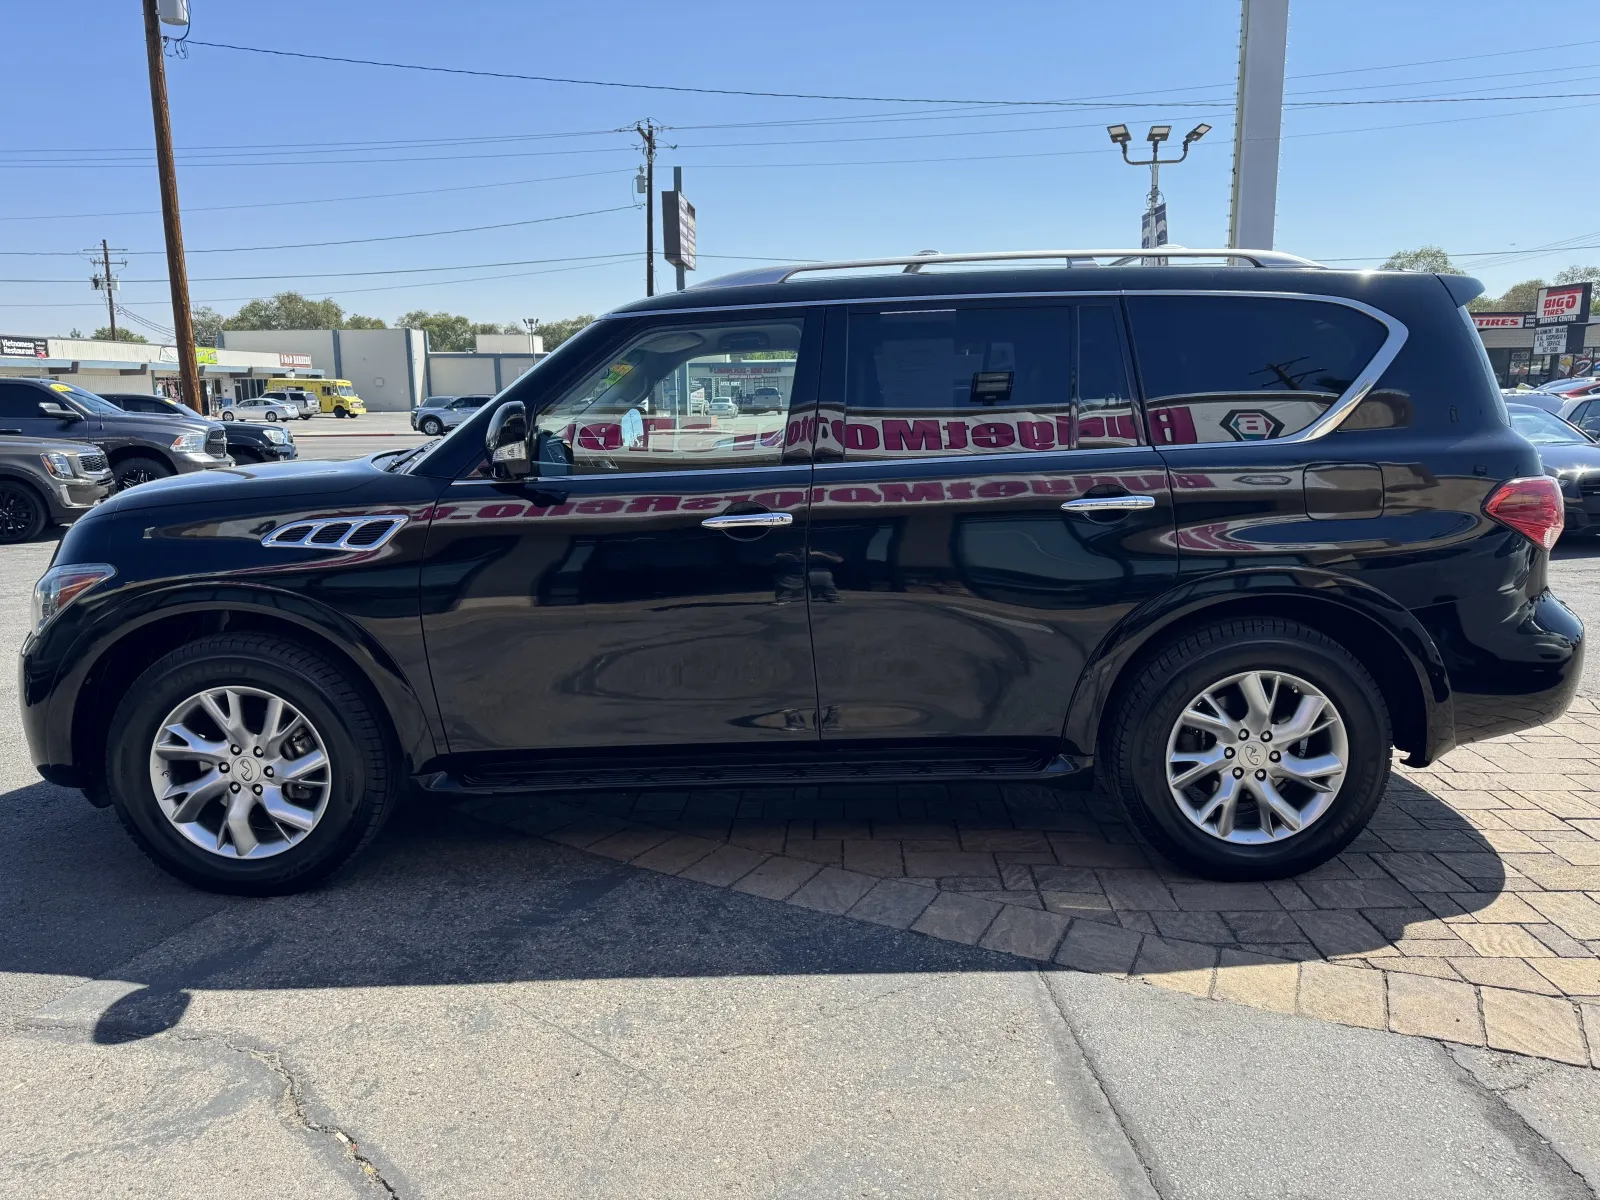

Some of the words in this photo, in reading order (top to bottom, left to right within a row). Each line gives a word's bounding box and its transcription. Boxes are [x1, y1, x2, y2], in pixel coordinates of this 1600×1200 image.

[1543, 297, 1565, 309] BIG
[1543, 308, 1565, 317] TIRES
[1477, 318, 1519, 327] TIRES
[1539, 315, 1558, 325] SERVICE
[1558, 314, 1577, 322] CENTER
[2, 339, 35, 348] Vietnamese
[4, 346, 36, 355] Restaurant
